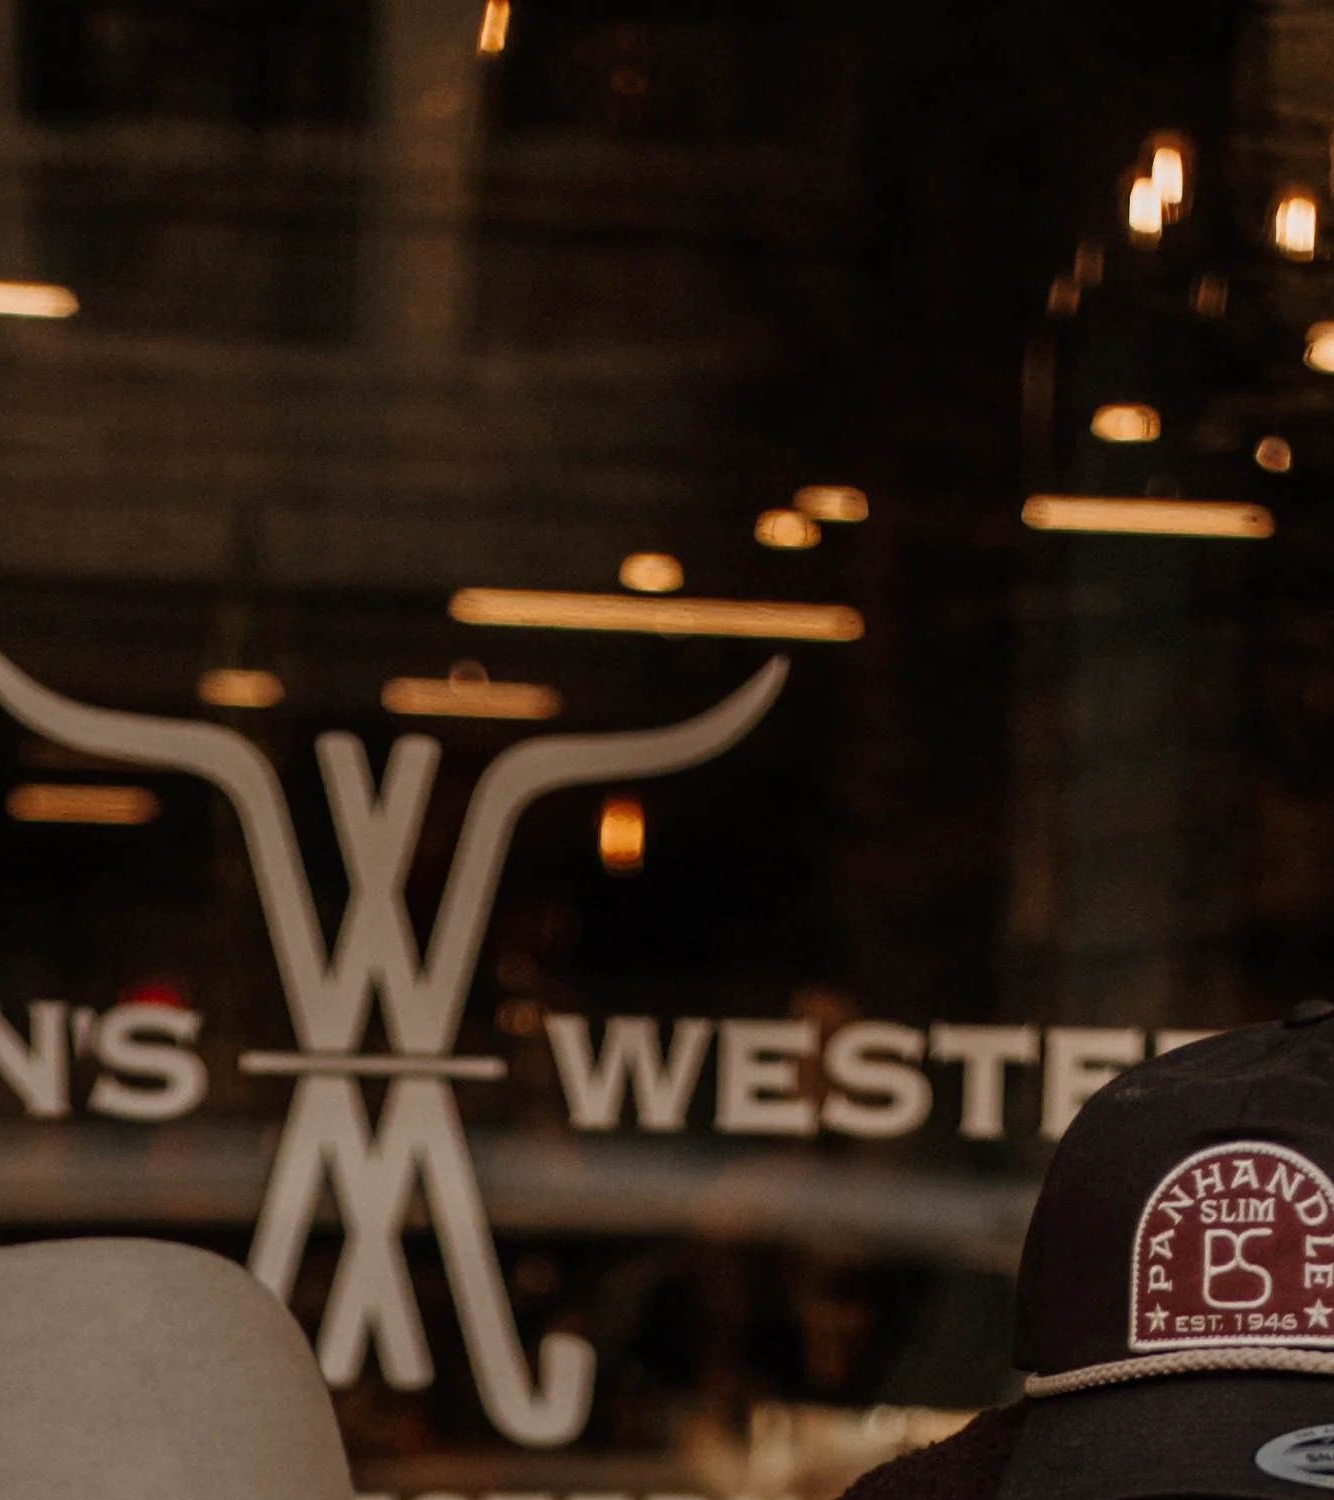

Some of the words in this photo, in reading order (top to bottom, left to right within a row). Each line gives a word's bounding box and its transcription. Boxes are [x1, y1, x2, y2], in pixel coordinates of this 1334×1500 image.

[544, 1011, 1229, 1142] WESTE
[1199, 1197, 1276, 1224] SLIM
[1235, 1313, 1298, 1332] 1946
